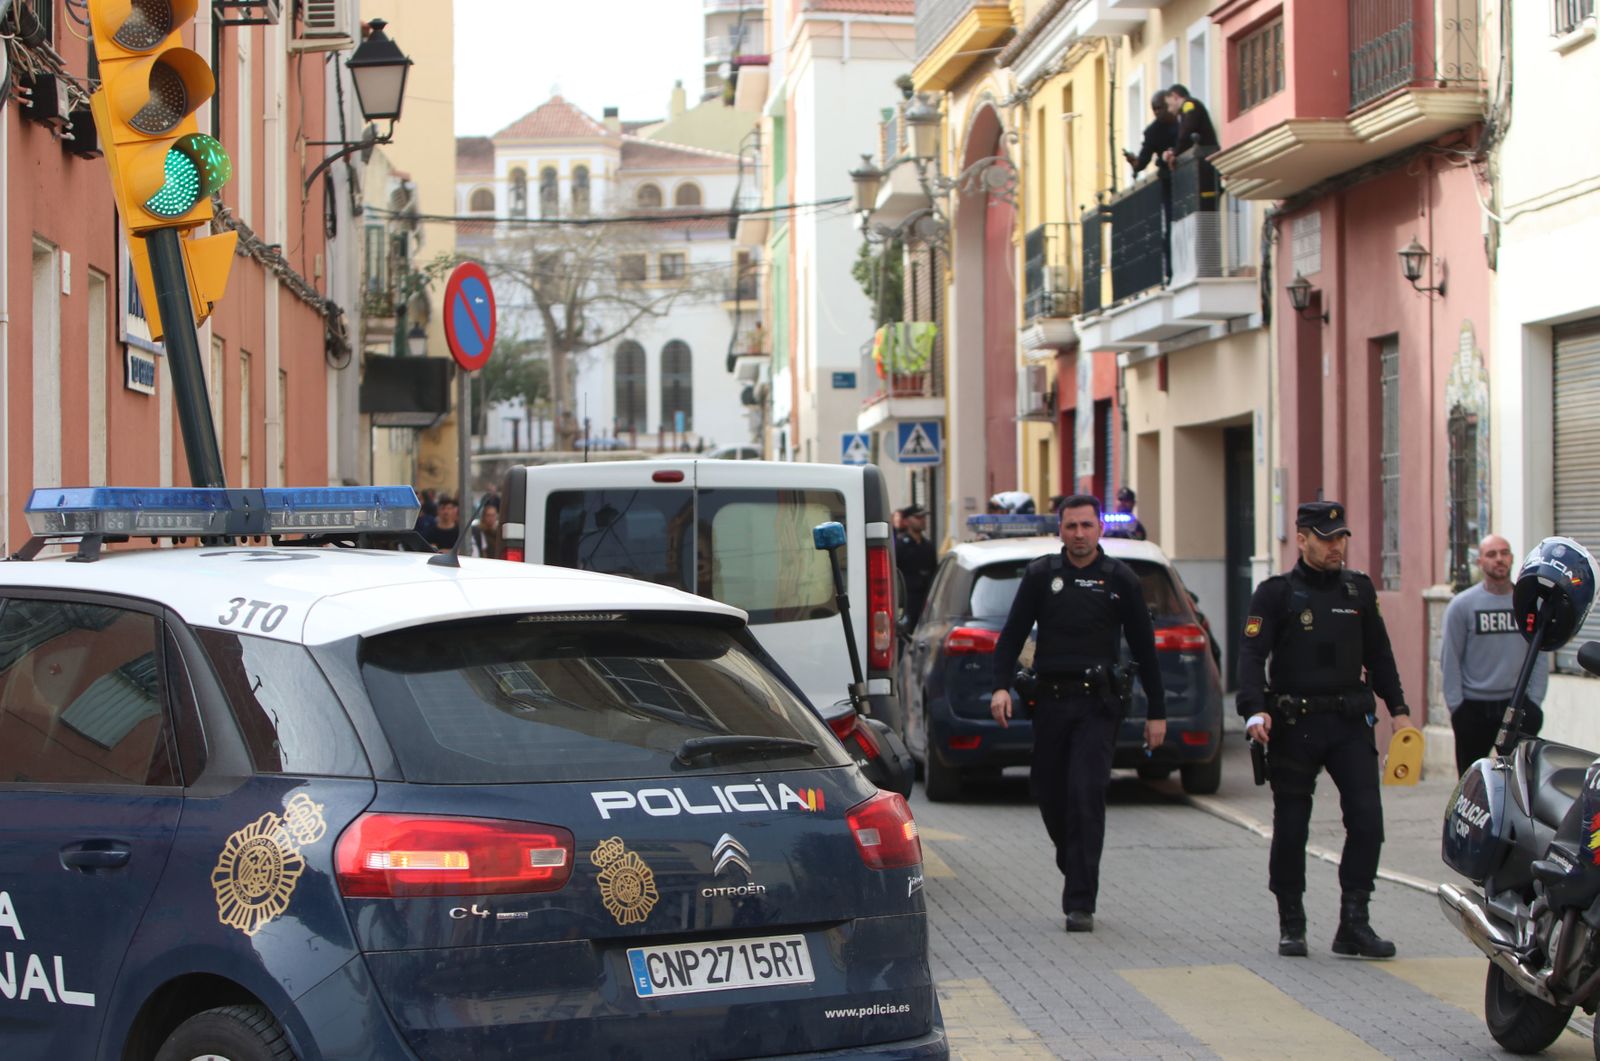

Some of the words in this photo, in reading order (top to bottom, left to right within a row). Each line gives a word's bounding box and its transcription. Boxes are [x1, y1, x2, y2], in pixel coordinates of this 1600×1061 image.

[1454, 794, 1490, 829] POLICIA
[1456, 819, 1470, 839] CNP
[449, 904, 491, 919] C4
[639, 977, 648, 988] E
[825, 1003, 910, 1019] www.policia.es
